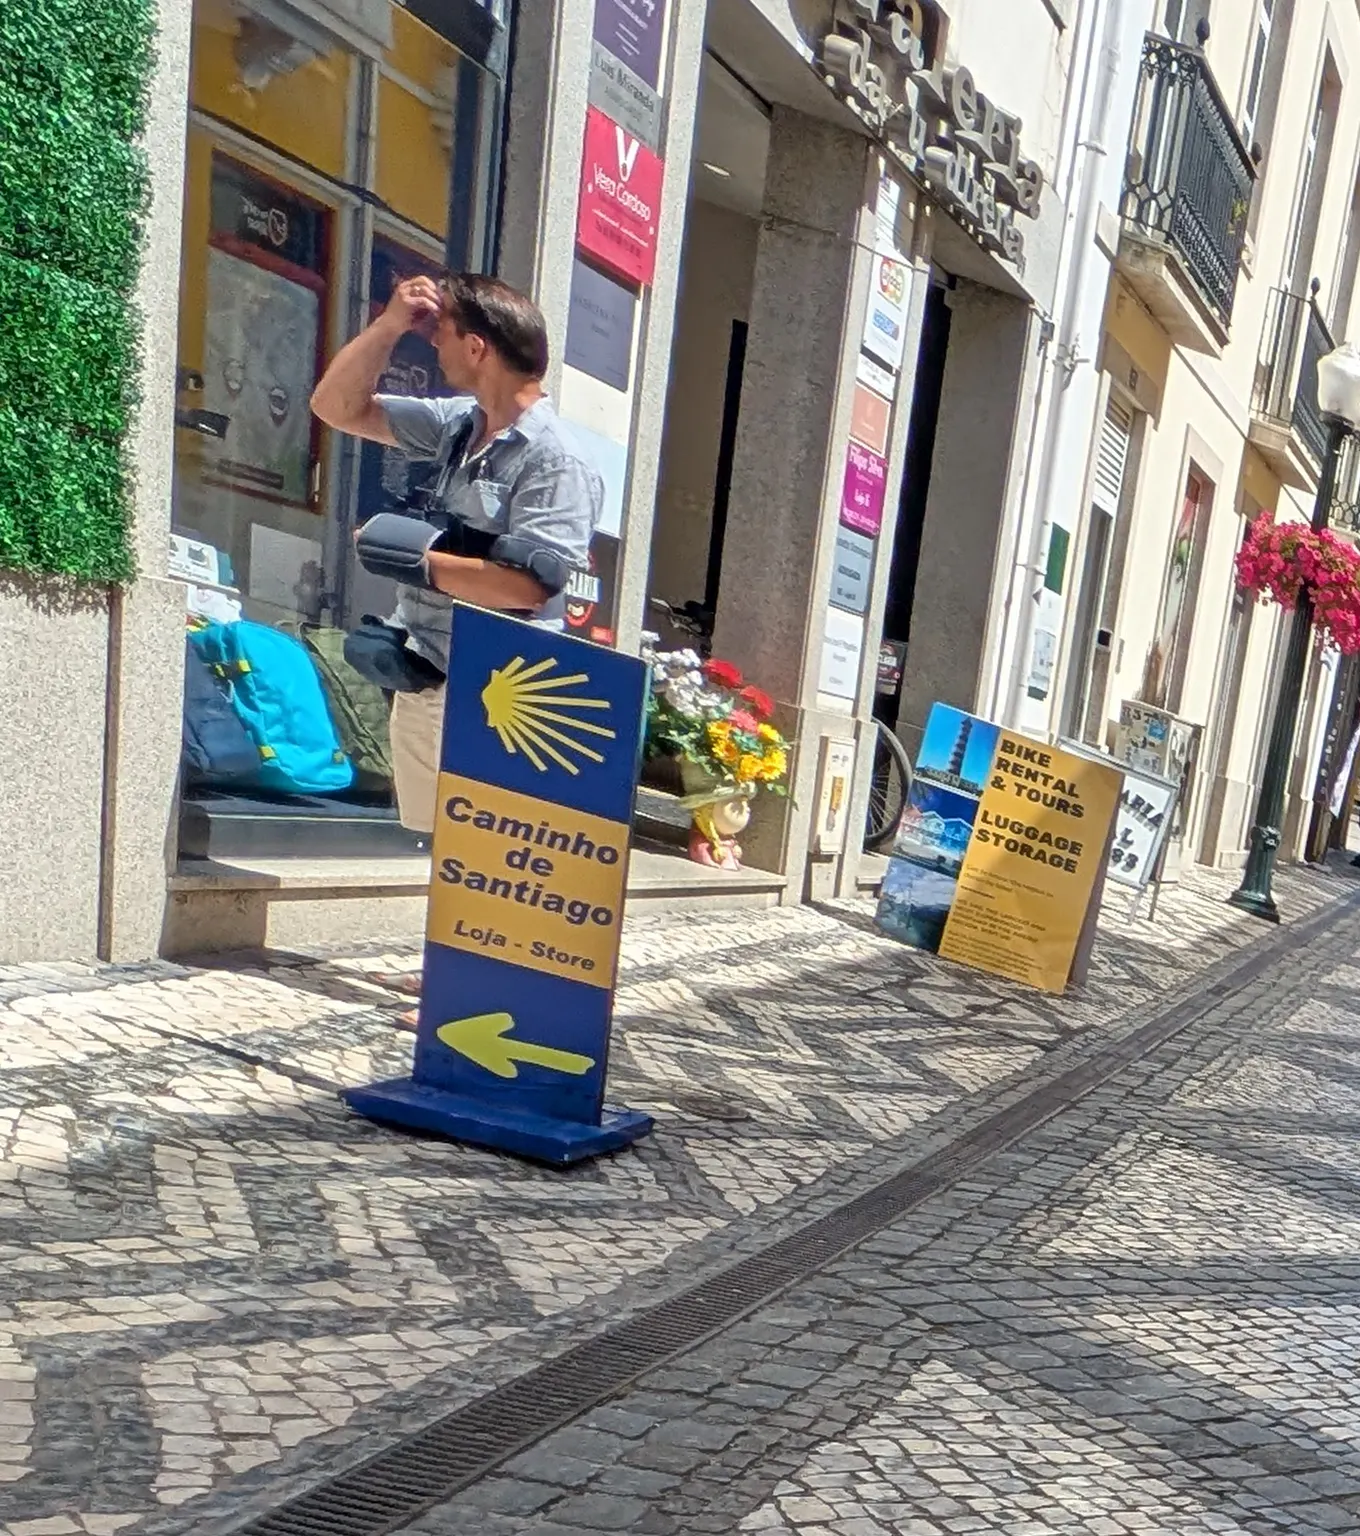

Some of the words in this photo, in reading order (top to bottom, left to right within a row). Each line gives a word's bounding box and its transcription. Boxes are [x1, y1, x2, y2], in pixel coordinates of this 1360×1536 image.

[857, 0, 1043, 208] aleria
[1000, 738, 1052, 768] BIKE
[991, 776, 1006, 792] &
[1014, 782, 1085, 819] TOURS
[996, 756, 1080, 798] RENTAL
[446, 796, 619, 865] Caminho
[1120, 789, 1164, 828] ARIA
[975, 828, 1079, 874] STORAGE
[981, 809, 1084, 858] LUGGAGE
[505, 847, 554, 877] de
[438, 858, 613, 926] Santiago
[454, 920, 507, 947] Loja
[529, 940, 595, 970] Store
